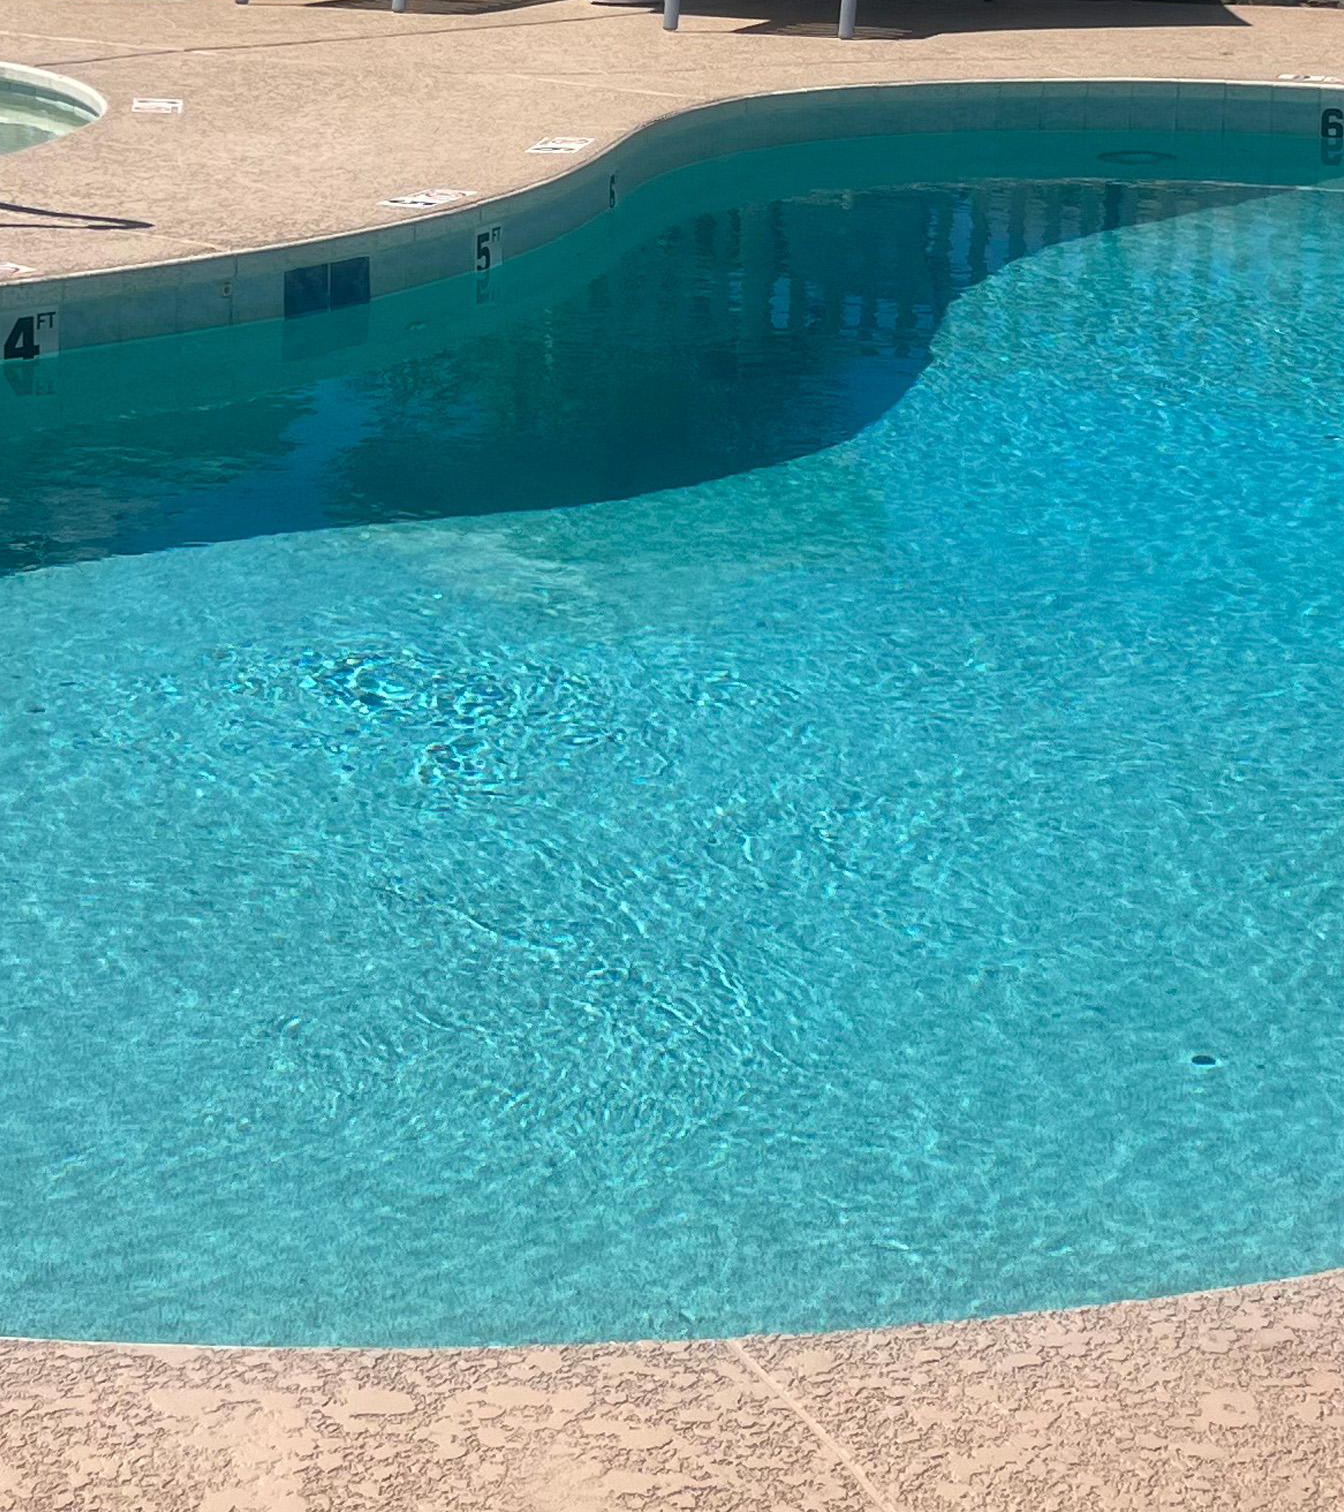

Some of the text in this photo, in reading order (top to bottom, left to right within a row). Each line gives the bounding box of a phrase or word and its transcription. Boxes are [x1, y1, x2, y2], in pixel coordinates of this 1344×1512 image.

[1321, 108, 1344, 138] 6
[476, 232, 491, 271] 5
[3, 311, 56, 360] 4 FT
